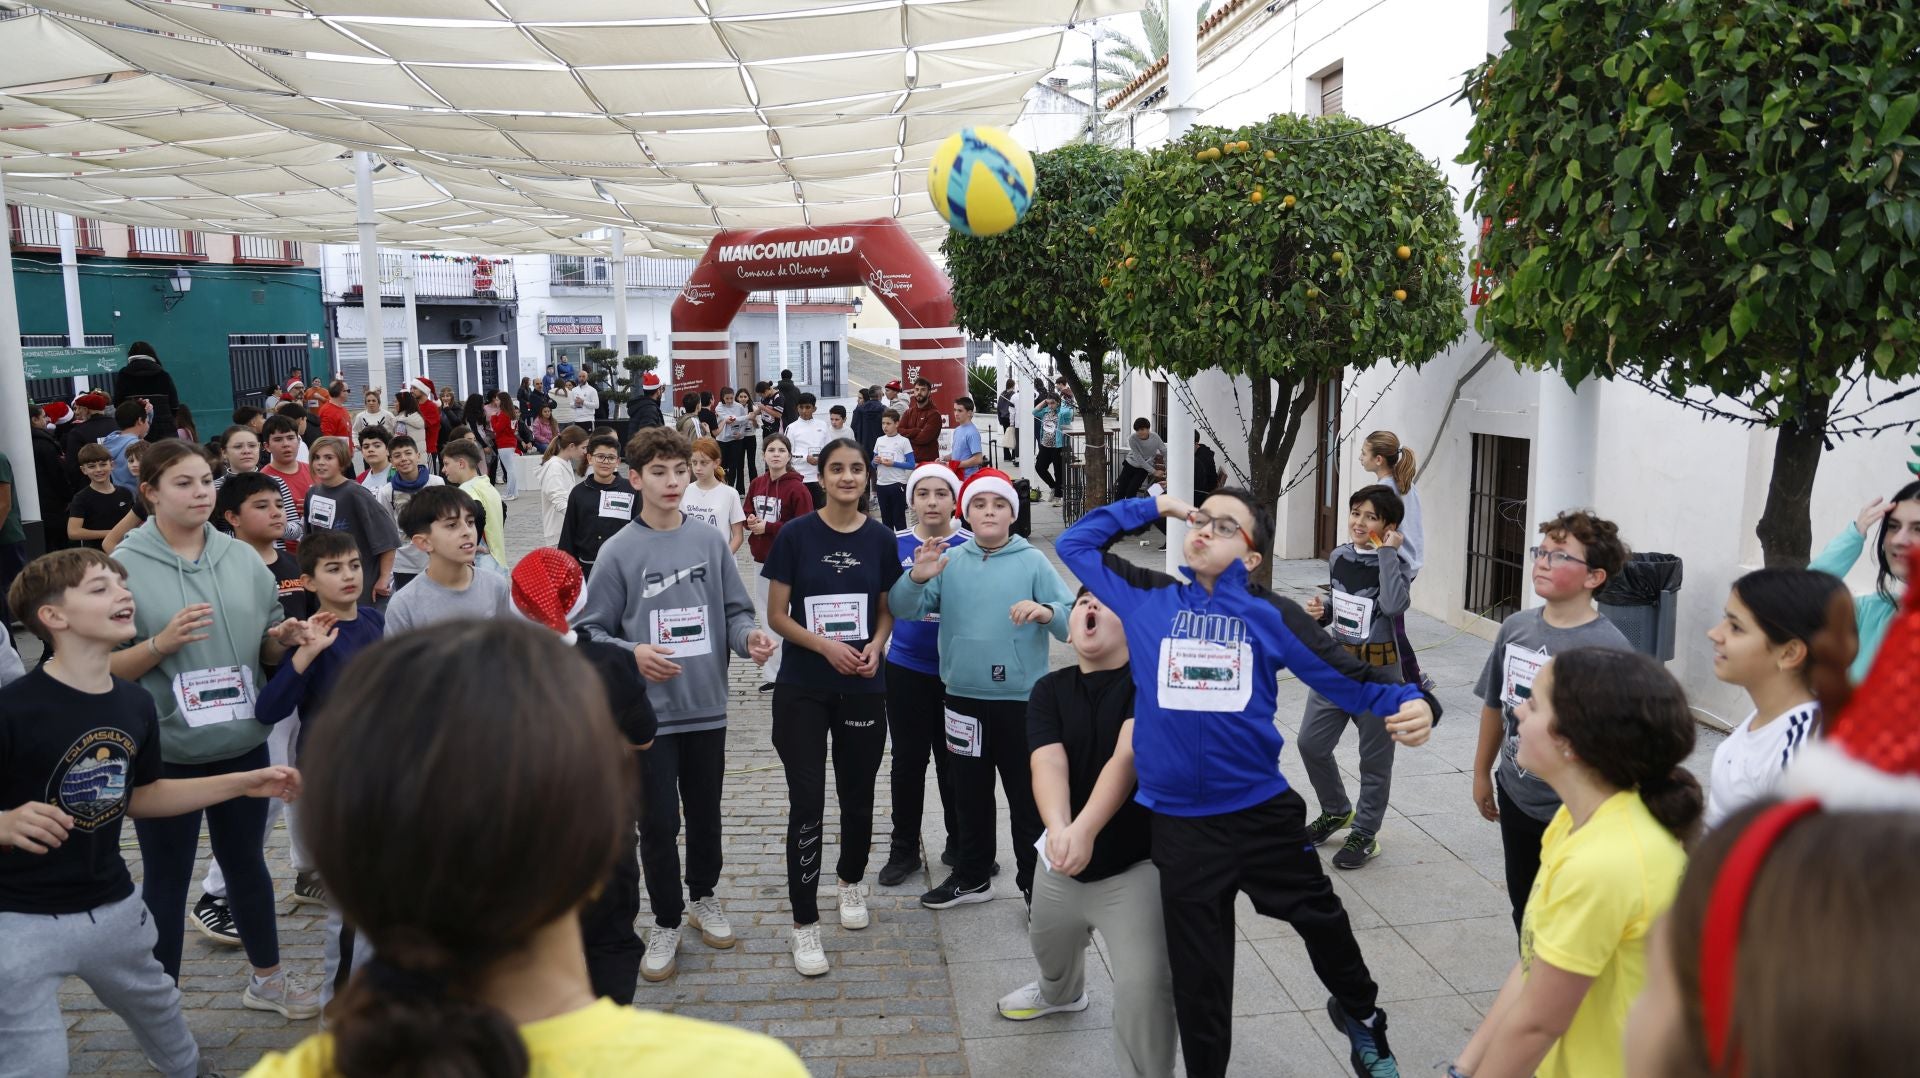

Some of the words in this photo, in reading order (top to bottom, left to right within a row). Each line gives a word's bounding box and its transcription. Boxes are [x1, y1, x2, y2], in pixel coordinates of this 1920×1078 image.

[718, 236, 854, 262] MANCOMUNIDAD
[737, 265, 775, 279] Comarca
[778, 263, 788, 277] de
[789, 261, 830, 278] Olivenza
[645, 567, 707, 591] AIR
[1171, 609, 1247, 644] PUMA
[844, 719, 855, 727] AIR
